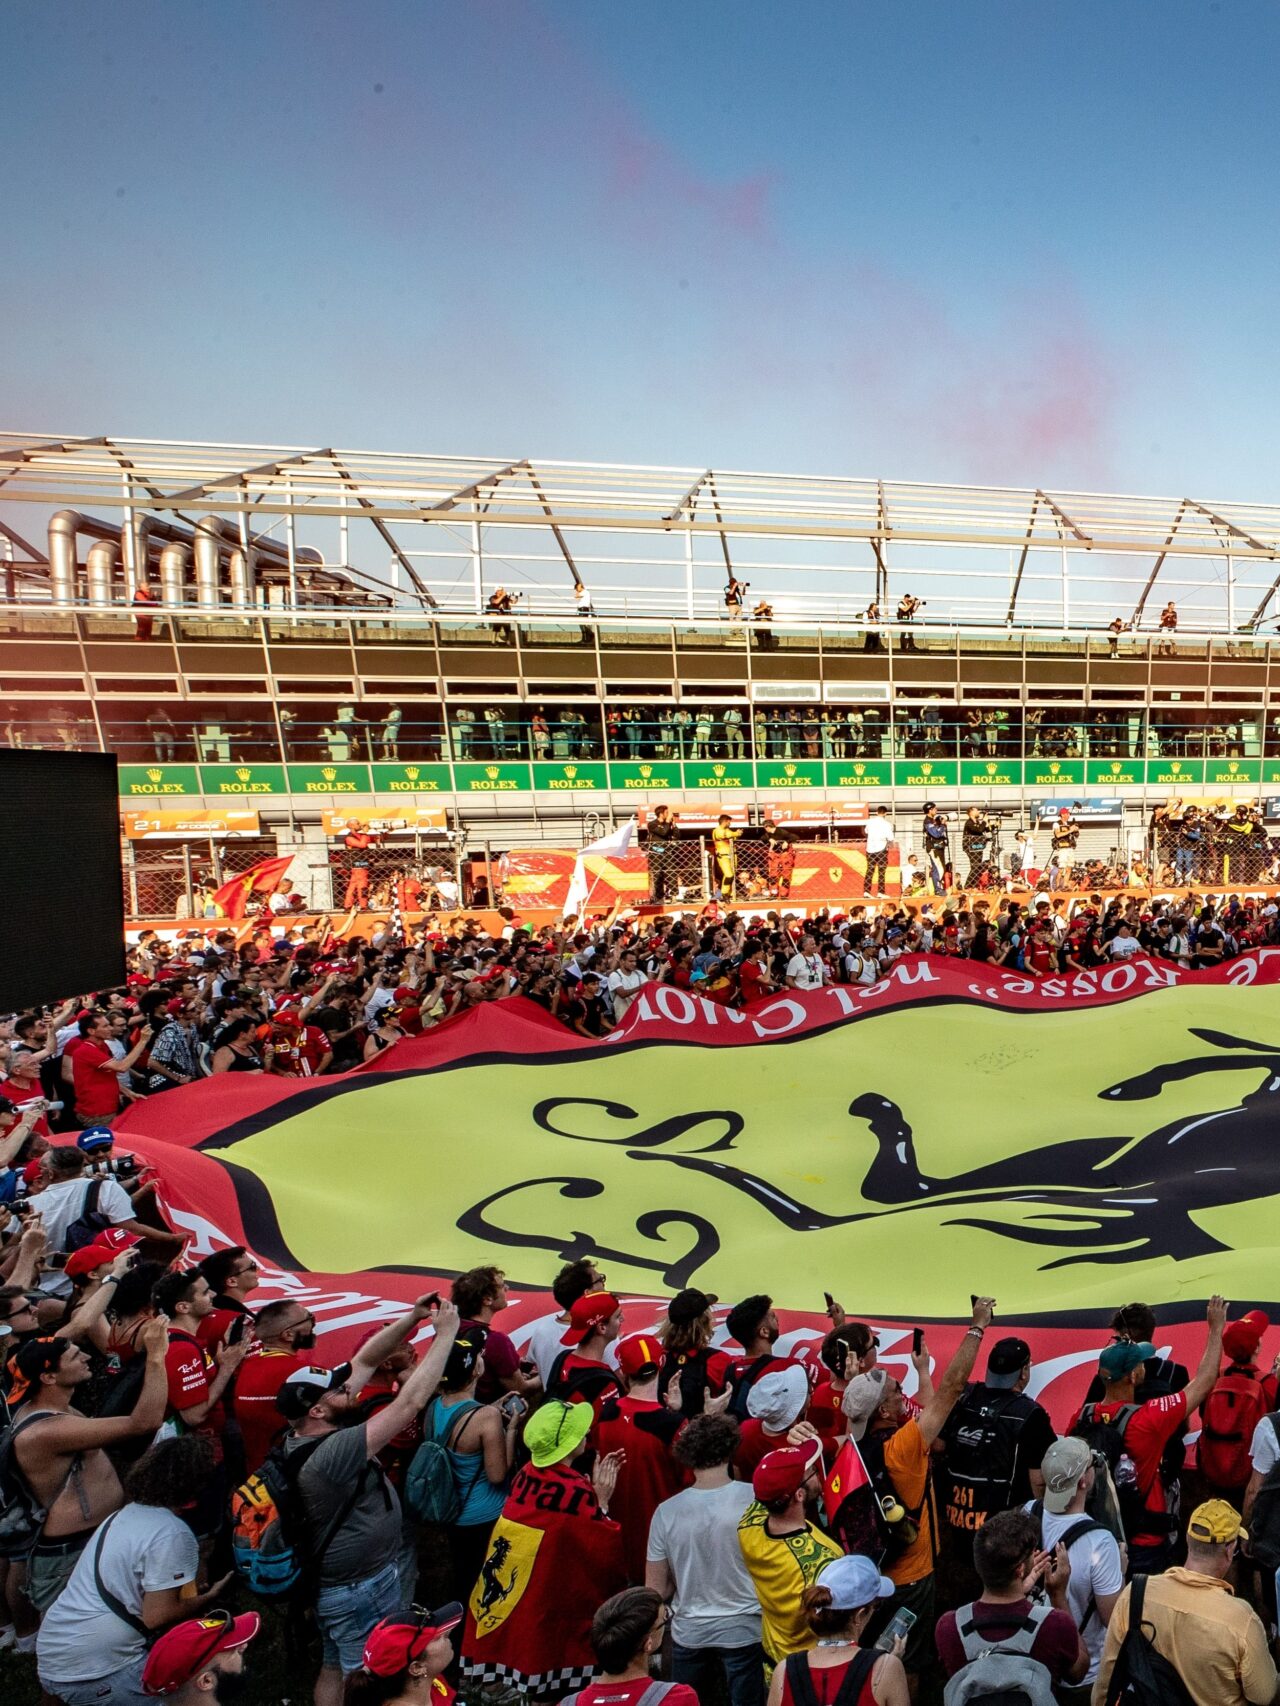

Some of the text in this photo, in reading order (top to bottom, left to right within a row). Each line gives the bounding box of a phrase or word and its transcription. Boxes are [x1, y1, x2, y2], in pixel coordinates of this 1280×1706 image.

[698, 778, 741, 787] ROLEX
[770, 777, 812, 786] ROLEX
[840, 777, 880, 786] ROLEX
[907, 776, 945, 785] ROLEX
[972, 776, 1011, 785] ROLEX
[1036, 775, 1073, 784] ROLEX
[1098, 775, 1134, 783] ROLEX
[1158, 775, 1192, 783] ROLEX
[1216, 774, 1250, 783] ROLEX
[130, 783, 185, 793] ROLEX
[219, 782, 272, 792] ROLEX
[306, 782, 357, 791] ROLEX
[390, 781, 438, 791] ROLEX
[470, 780, 517, 790] ROLEX
[549, 779, 594, 789] ROLEX
[625, 779, 669, 788] ROLEX
[771, 810, 792, 819] 51
[1038, 806, 1058, 815] 10
[134, 820, 160, 831] 21
[827, 960, 940, 1014] nel
[953, 1485, 974, 1508] 261
